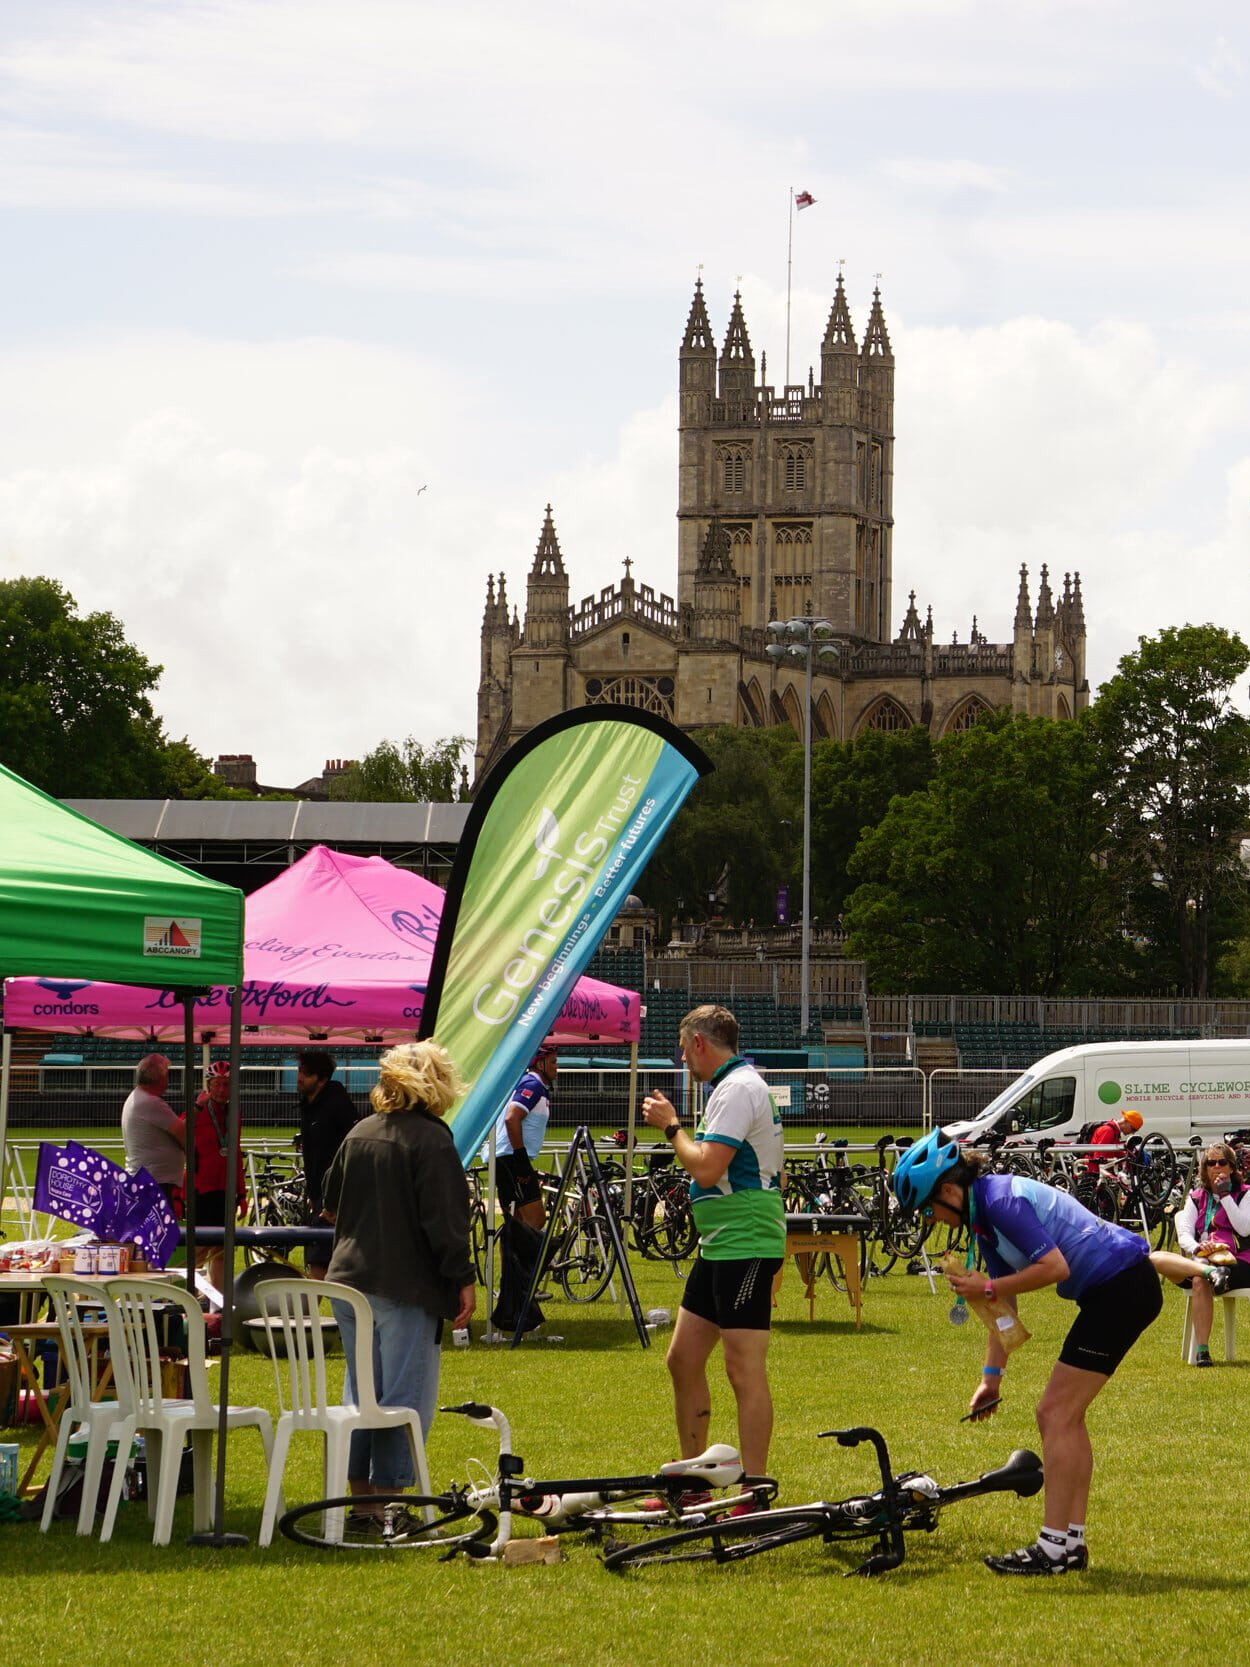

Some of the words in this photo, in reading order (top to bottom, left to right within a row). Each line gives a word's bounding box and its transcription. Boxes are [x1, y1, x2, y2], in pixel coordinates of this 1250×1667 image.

[518, 995, 543, 1028] New
[539, 913, 591, 992] beginnings
[595, 852, 627, 898] Better
[621, 797, 656, 851] futures
[146, 946, 199, 956] ABCCANOPY
[312, 943, 428, 962] Events
[33, 1001, 100, 1016] condors
[1124, 1083, 1171, 1095] SLIME
[50, 1179, 75, 1192] HOUSE
[51, 1170, 87, 1189] DOROTHY
